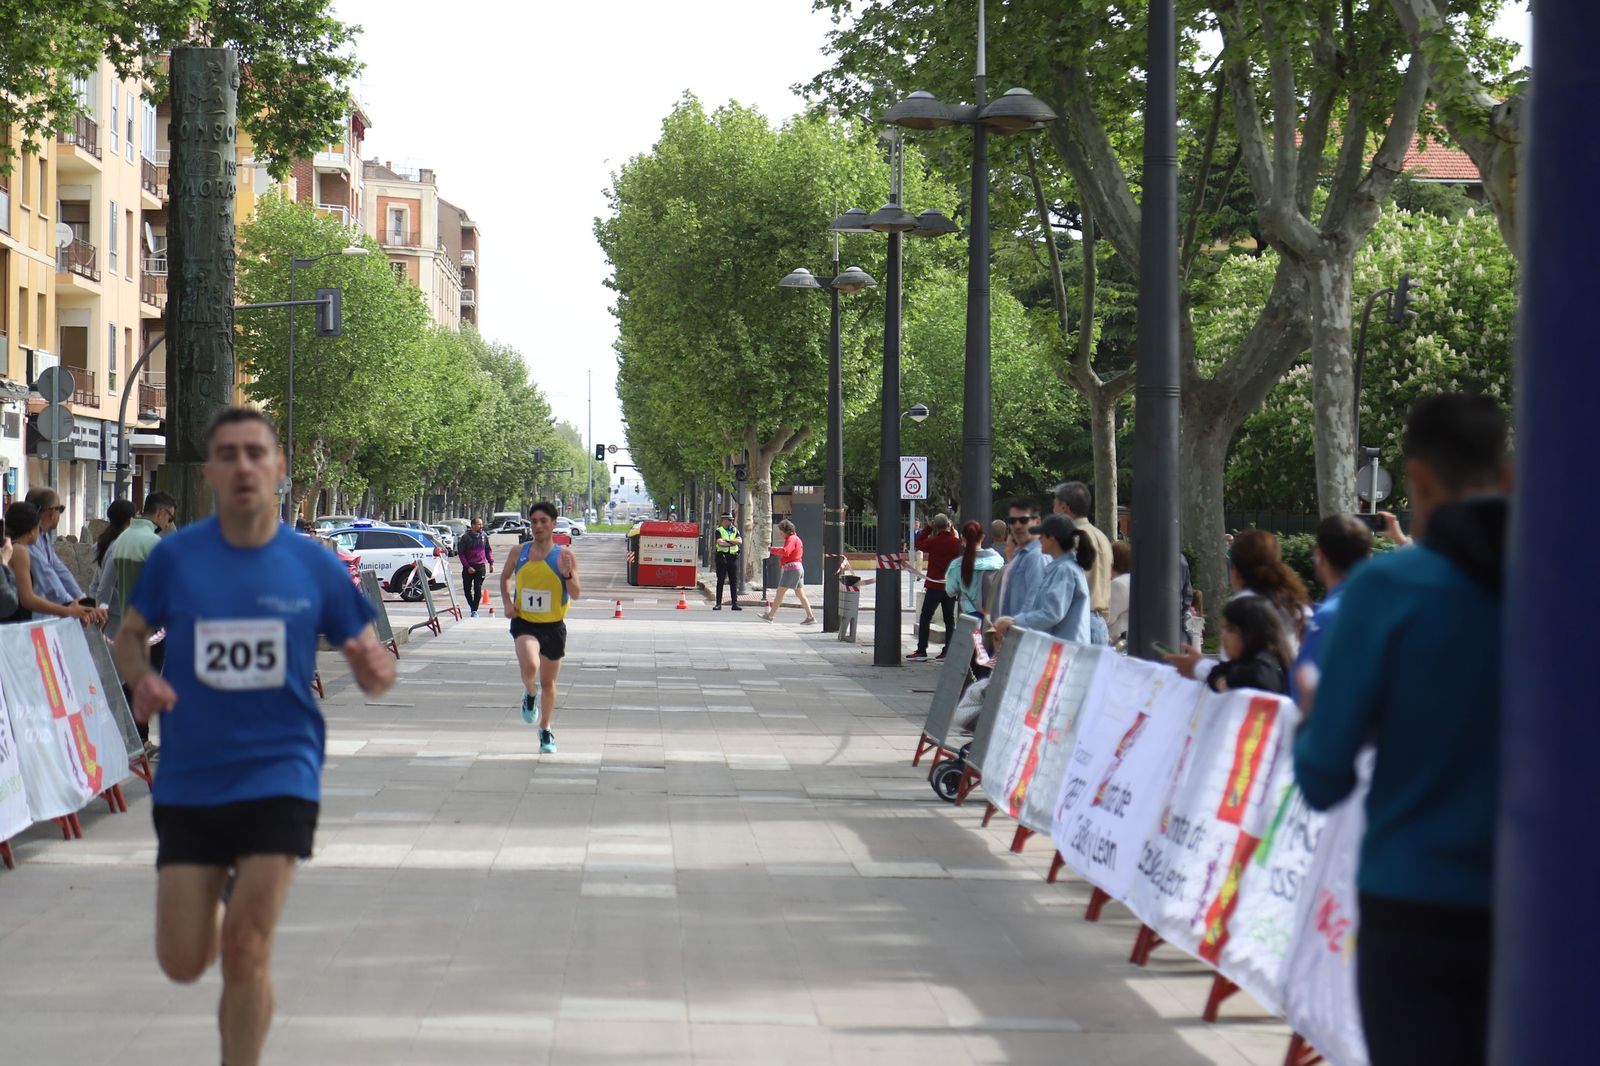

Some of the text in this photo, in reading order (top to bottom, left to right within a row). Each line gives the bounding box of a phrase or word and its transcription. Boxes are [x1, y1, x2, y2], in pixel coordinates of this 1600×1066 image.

[359, 562, 392, 571] Municipal
[528, 595, 542, 607] 11
[206, 641, 276, 672] 205
